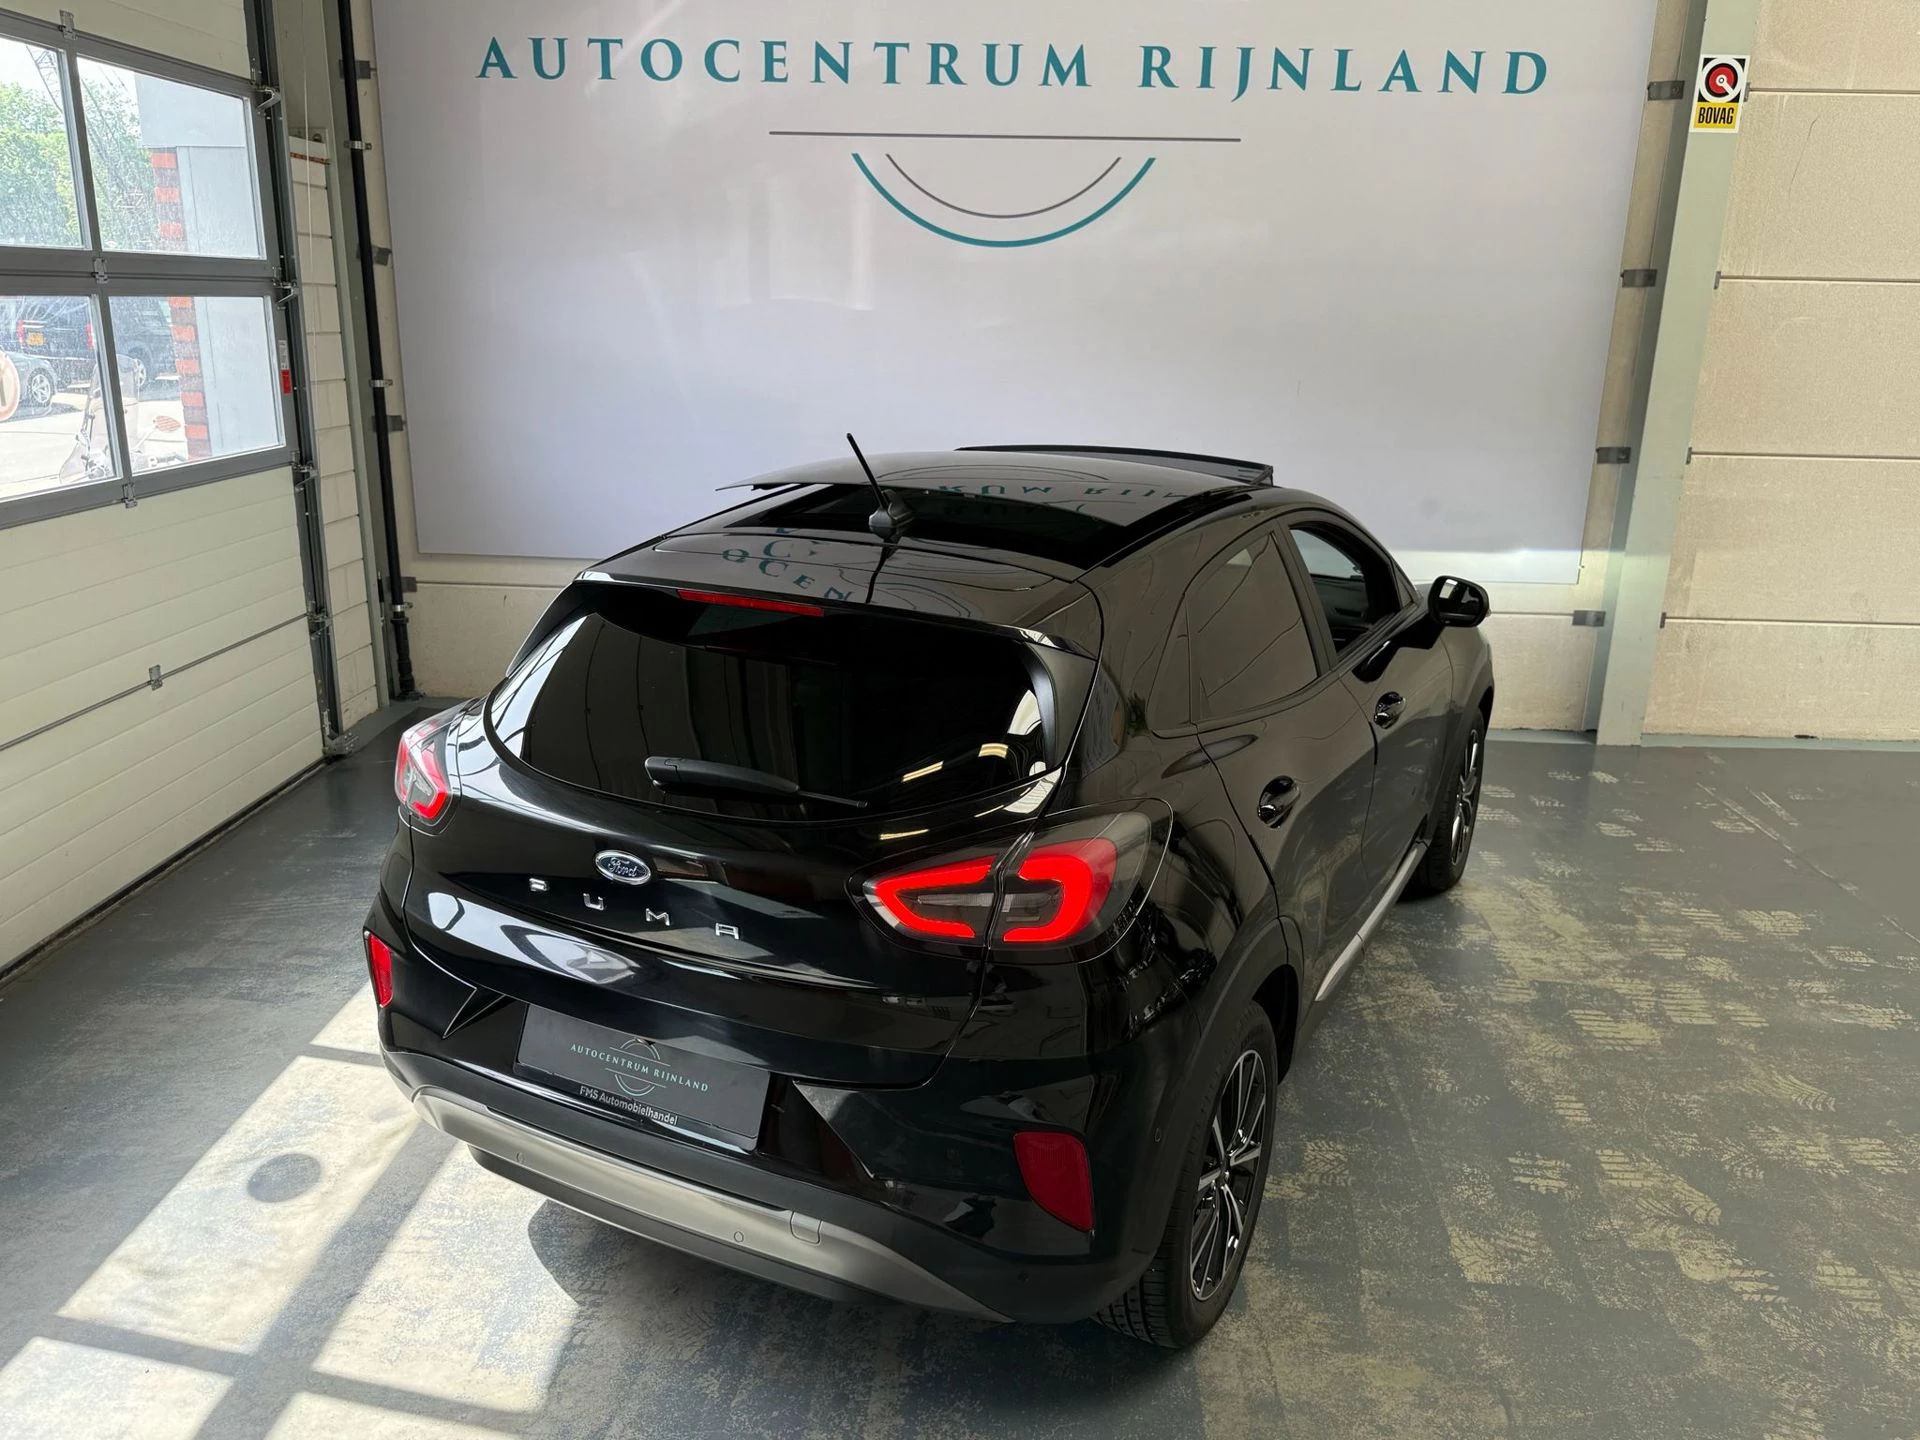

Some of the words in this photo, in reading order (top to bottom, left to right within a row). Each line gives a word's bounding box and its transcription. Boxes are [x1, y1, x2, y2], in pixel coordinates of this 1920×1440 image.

[475, 36, 1091, 87] AUTOCENTRUM
[1138, 45, 1549, 102] RIJNLAND
[1698, 107, 1735, 125] BOVAG
[608, 857, 637, 877] Ford
[529, 877, 740, 940] PUMA
[570, 1043, 649, 1075] AUTOCENTRUM
[653, 1068, 709, 1093] RIJNLAND
[580, 1085, 599, 1101] FMS
[600, 1091, 678, 1126] Automobielhandel
